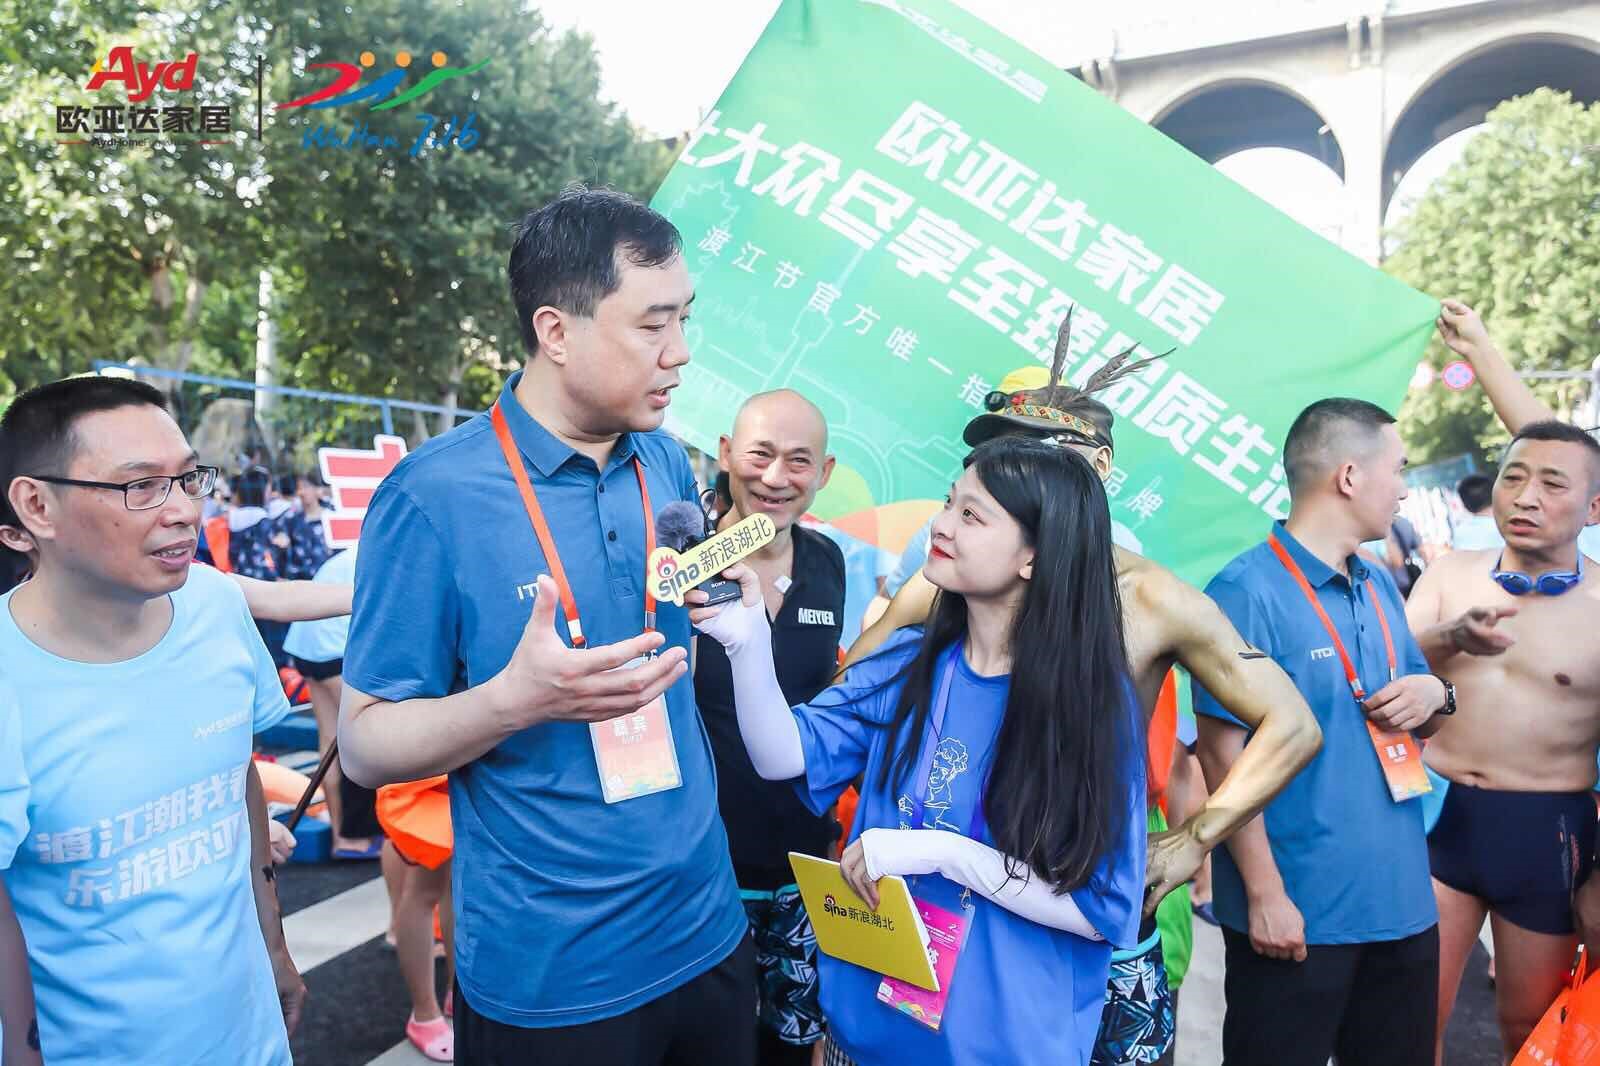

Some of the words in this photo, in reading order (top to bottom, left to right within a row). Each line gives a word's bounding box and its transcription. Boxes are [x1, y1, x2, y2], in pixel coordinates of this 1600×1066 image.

[874, 99, 1225, 345] 欧亚达家居
[658, 563, 701, 598] sina
[698, 517, 772, 575] 新浪湖北
[823, 900, 848, 918] sina
[848, 907, 895, 932] 新浪湖北
